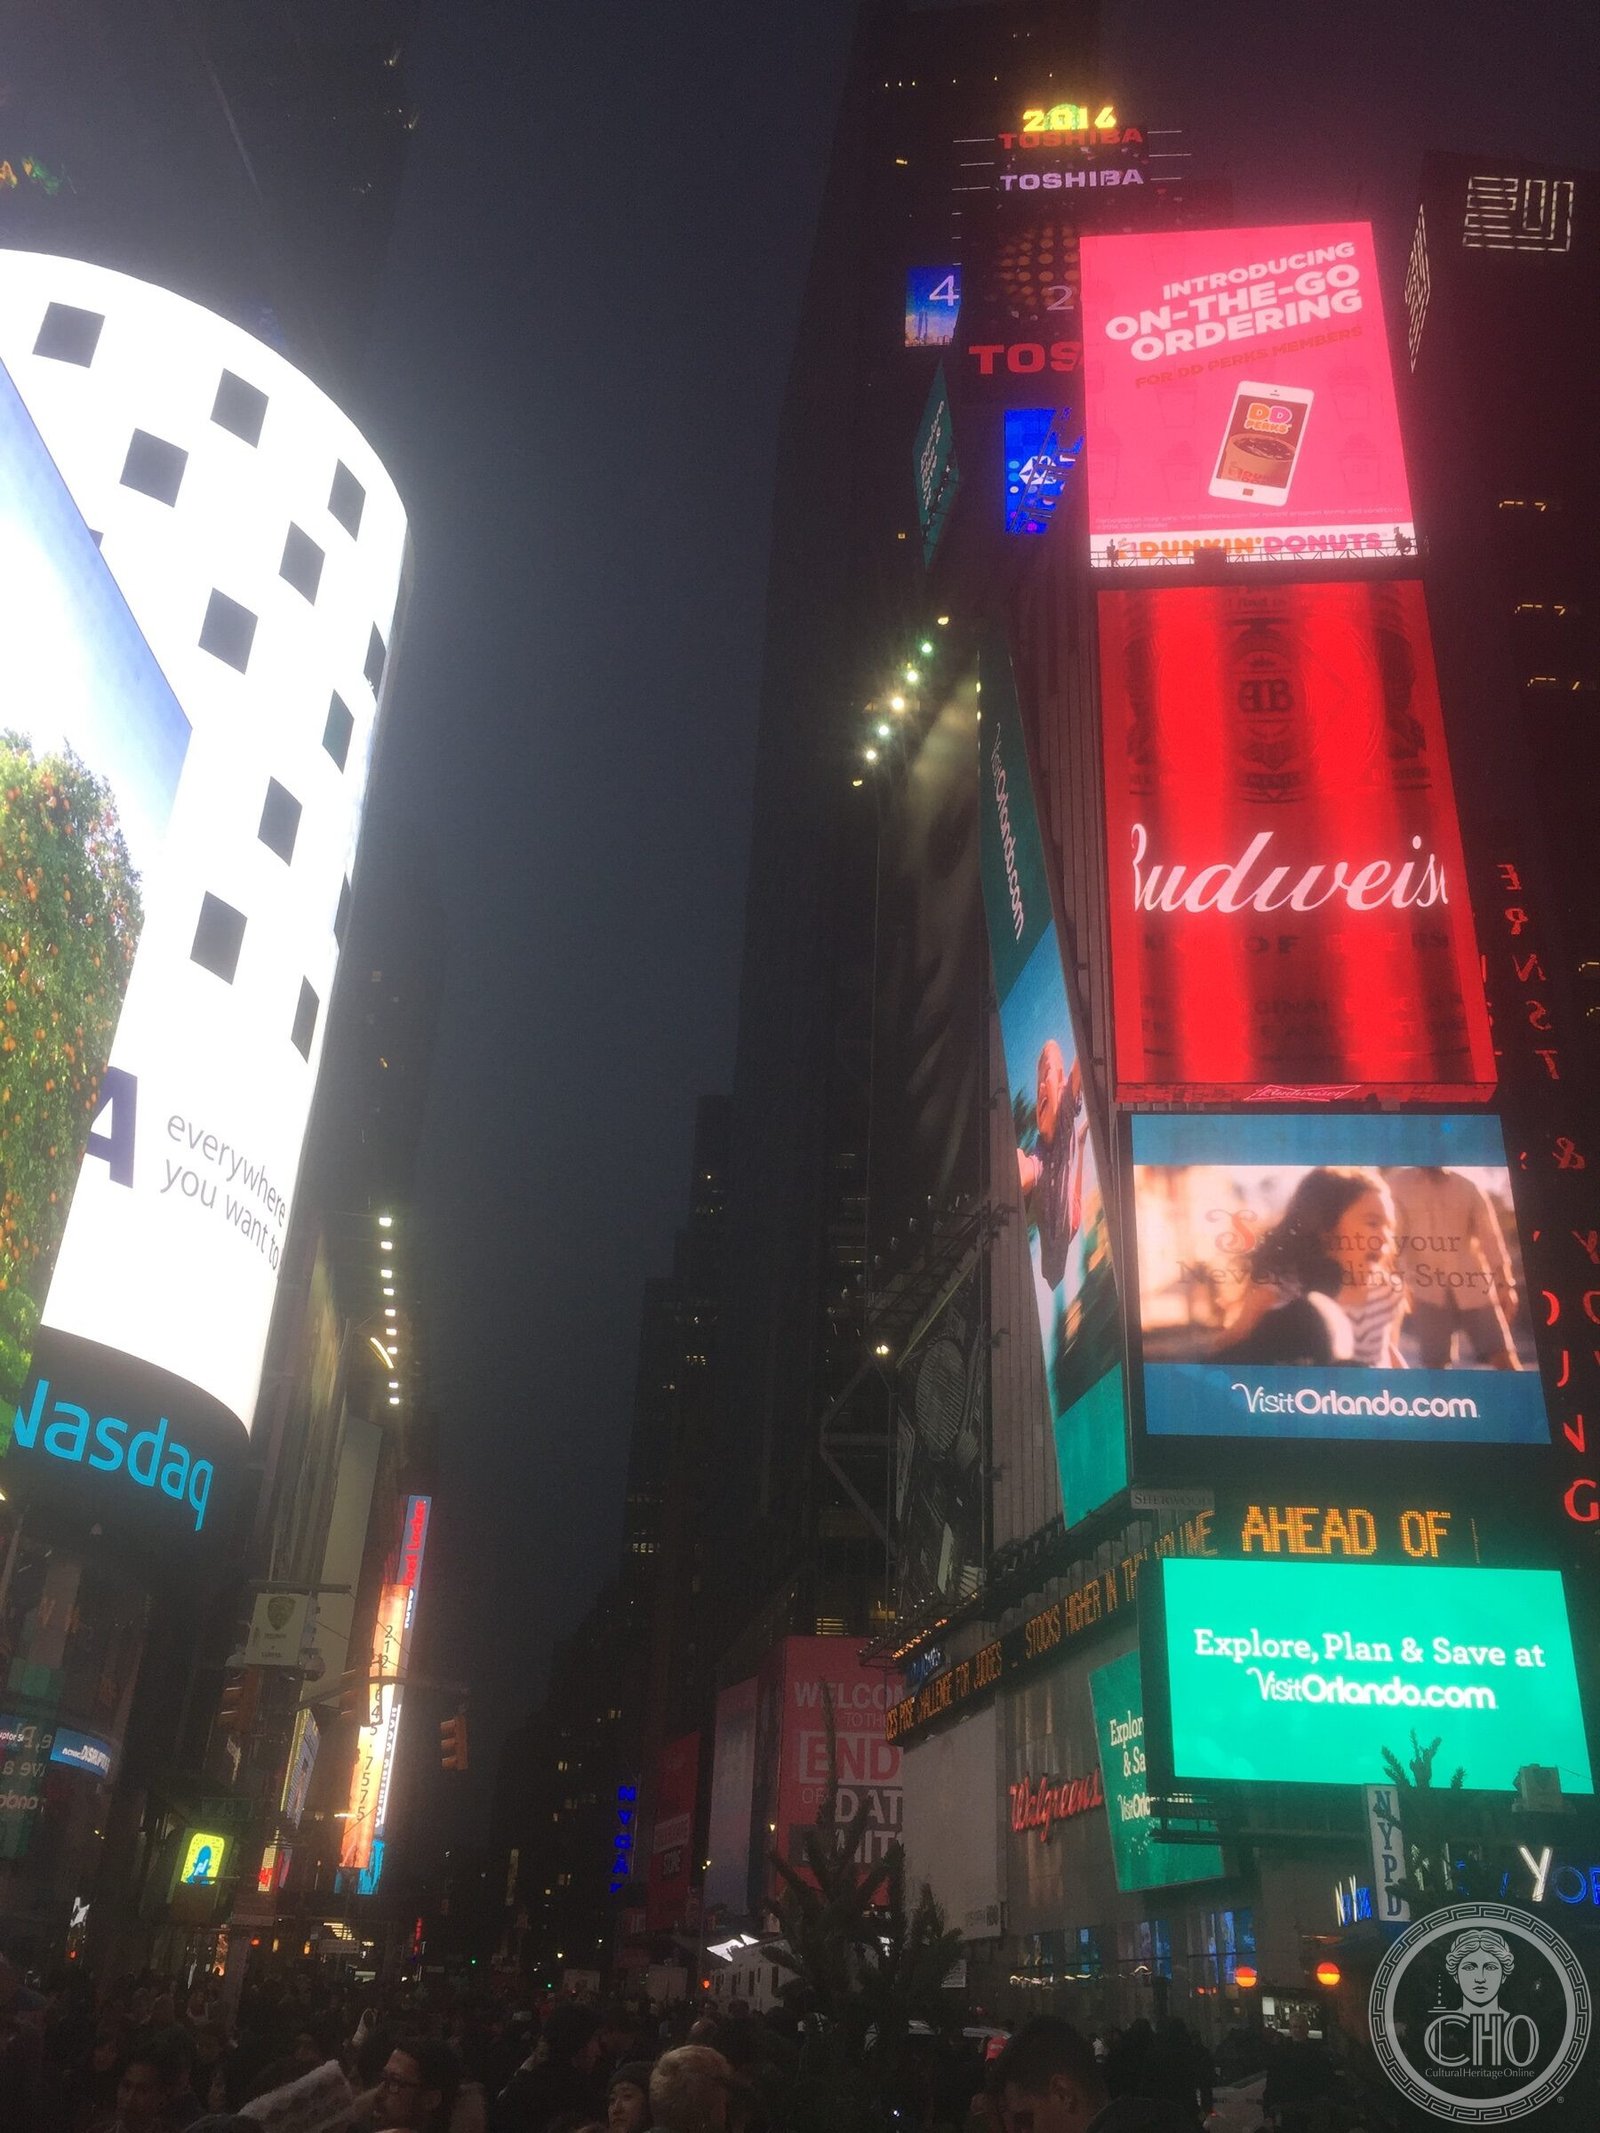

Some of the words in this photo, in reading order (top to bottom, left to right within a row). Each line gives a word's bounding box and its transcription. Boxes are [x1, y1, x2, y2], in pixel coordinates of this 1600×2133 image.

[998, 127, 1144, 149] TOSHIBA
[1022, 105, 1118, 132] 2016
[1000, 169, 1145, 191] TOSHIBA
[929, 274, 960, 307] 4
[1162, 241, 1356, 300] INTRODUCING
[1105, 263, 1360, 341] ON-THE-GO
[1130, 288, 1363, 361] ORDERING
[1135, 370, 1174, 389] FOR
[1177, 363, 1204, 379] DD
[1207, 347, 1270, 373] PERKS
[1271, 325, 1363, 356] MEMBERS
[1263, 531, 1383, 554] DONUTS
[166, 1114, 286, 1229] everywhere
[160, 1158, 218, 1209] you
[225, 1194, 271, 1254] want
[269, 1233, 280, 1271] to
[1393, 1233, 1462, 1260] your
[1231, 1383, 1480, 1418] VisitOrlando.com
[1025, 1604, 1061, 1660] STOCKS
[1241, 1505, 1377, 1556] AHEAD
[1400, 1510, 1451, 1558] OF
[1194, 1627, 1319, 1665] Explore,
[1322, 1631, 1393, 1663] Plan
[1400, 1637, 1425, 1665] &
[1432, 1636, 1506, 1667] Save
[1514, 1644, 1546, 1668] at
[1246, 1667, 1498, 1710] VisitOrlando.com
[1375, 1790, 1402, 1917] NYPD
